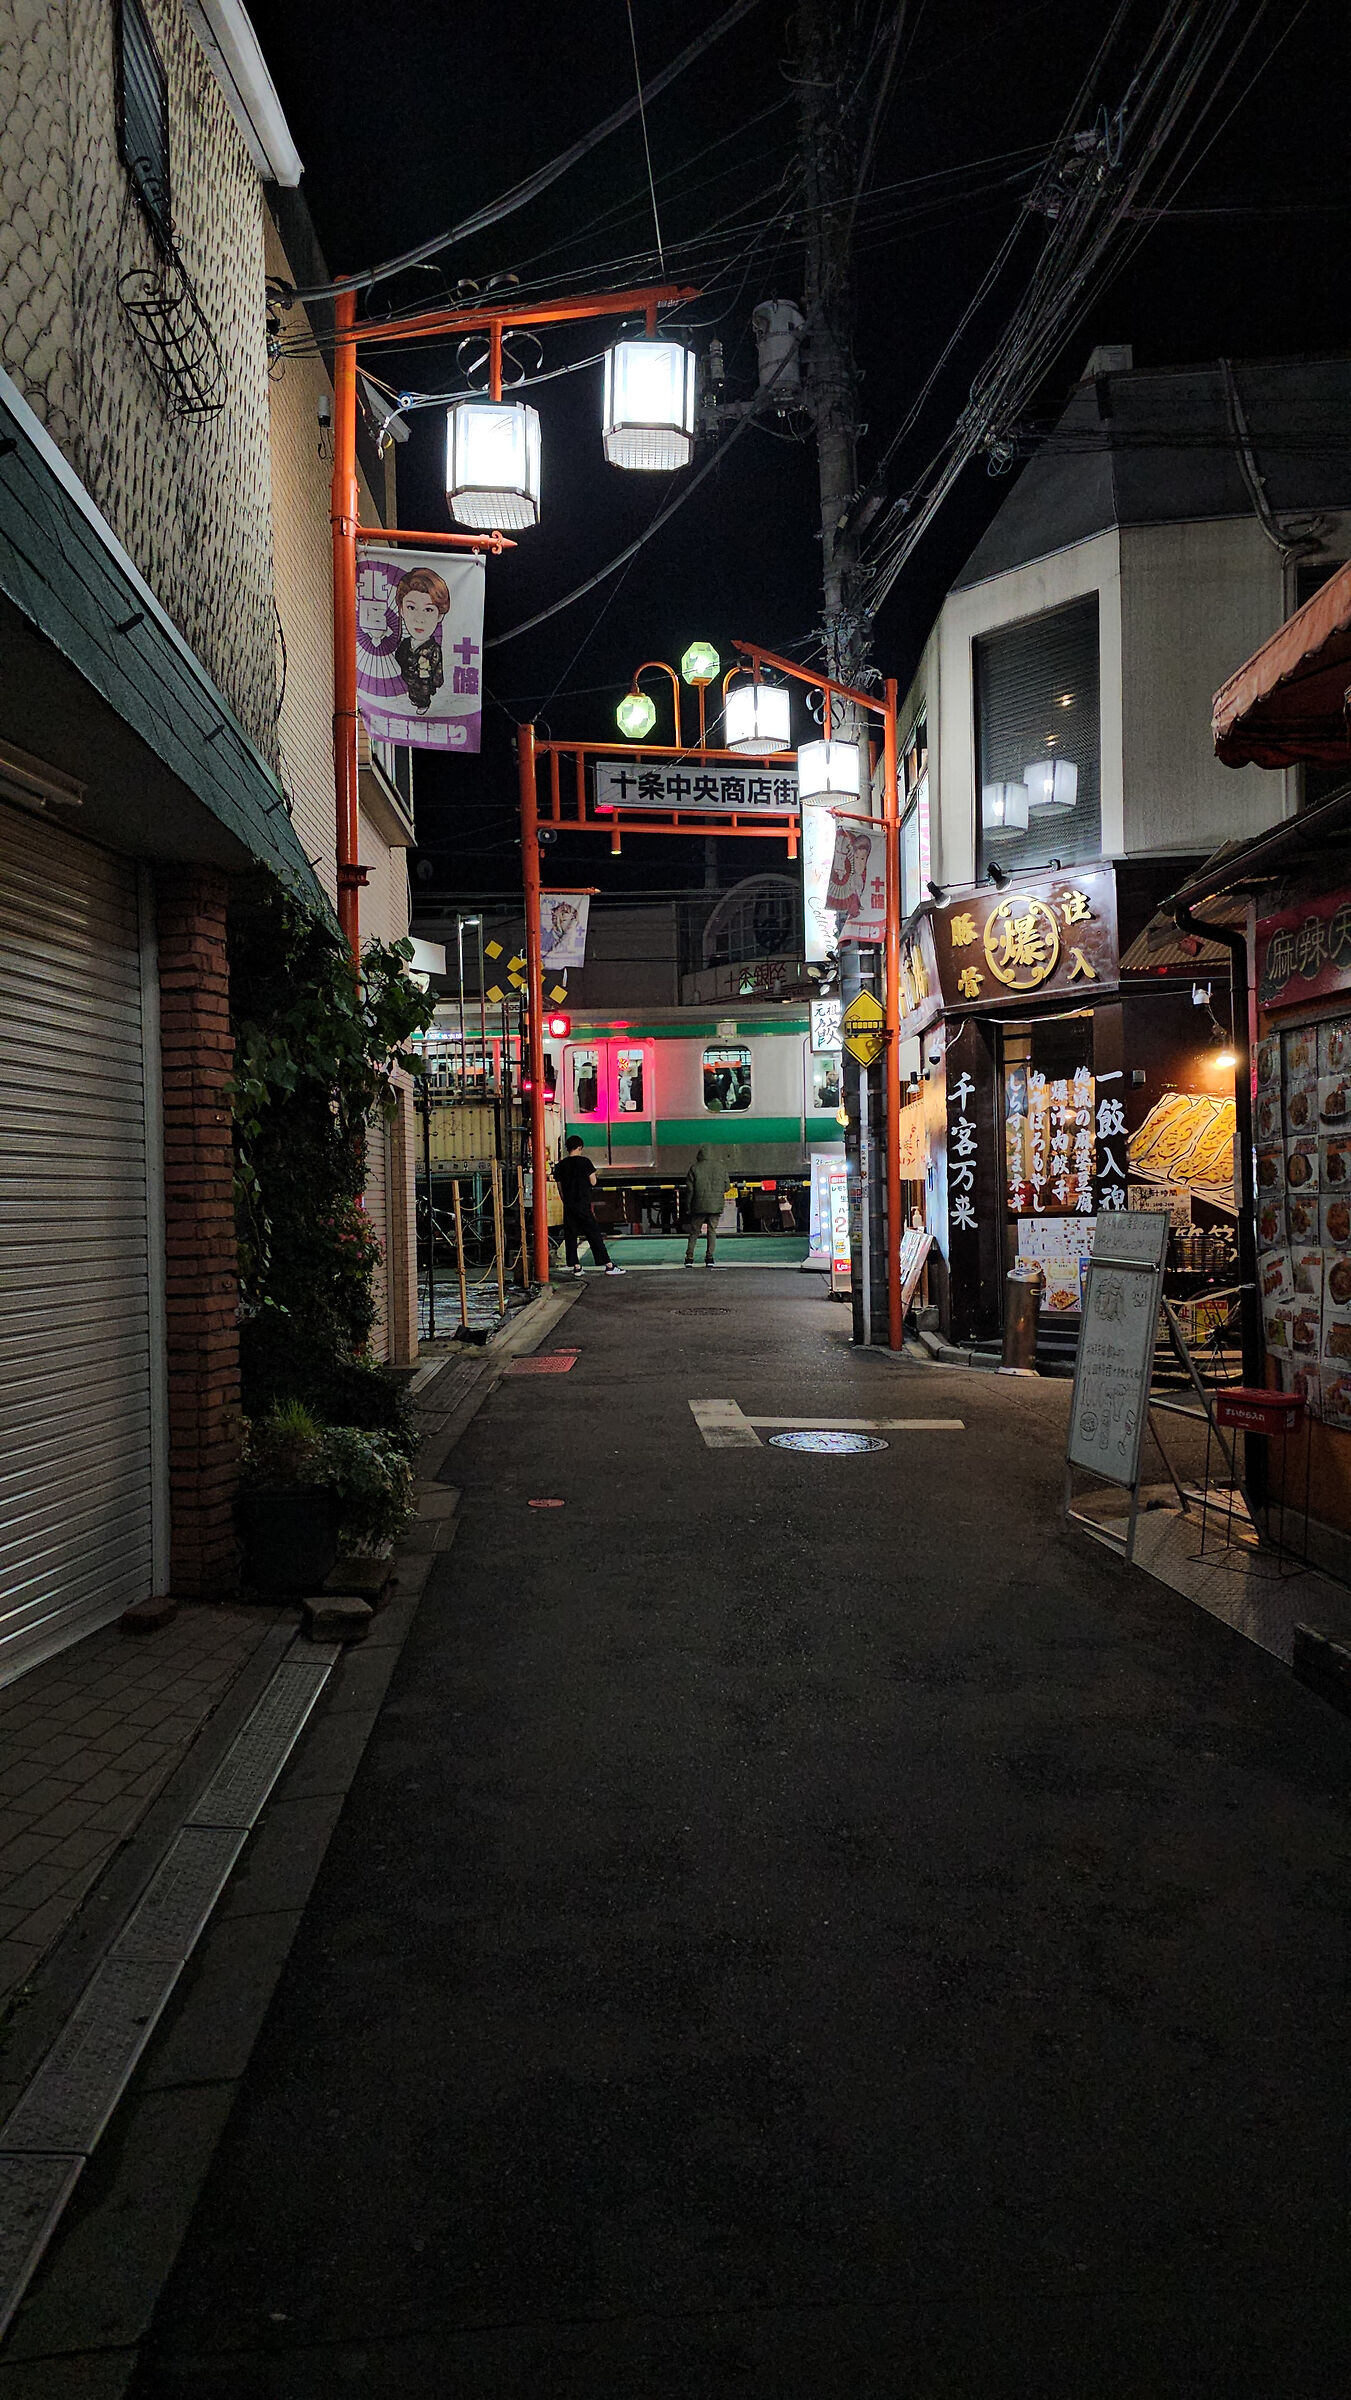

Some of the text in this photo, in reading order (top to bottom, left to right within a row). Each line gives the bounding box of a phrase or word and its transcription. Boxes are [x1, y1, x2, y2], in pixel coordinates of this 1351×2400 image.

[610, 770, 799, 805] 十条中央商店街
[950, 912, 985, 999] 豚骨
[999, 913, 1046, 967] 爆
[1061, 890, 1097, 980] 注入
[948, 1072, 979, 1231] 千客万来
[1050, 1079, 1070, 1201] 爆汁肉餃子
[1073, 1065, 1093, 1213] 俺流の麻婆豆腐
[1096, 1070, 1129, 1211] 一餃入魂
